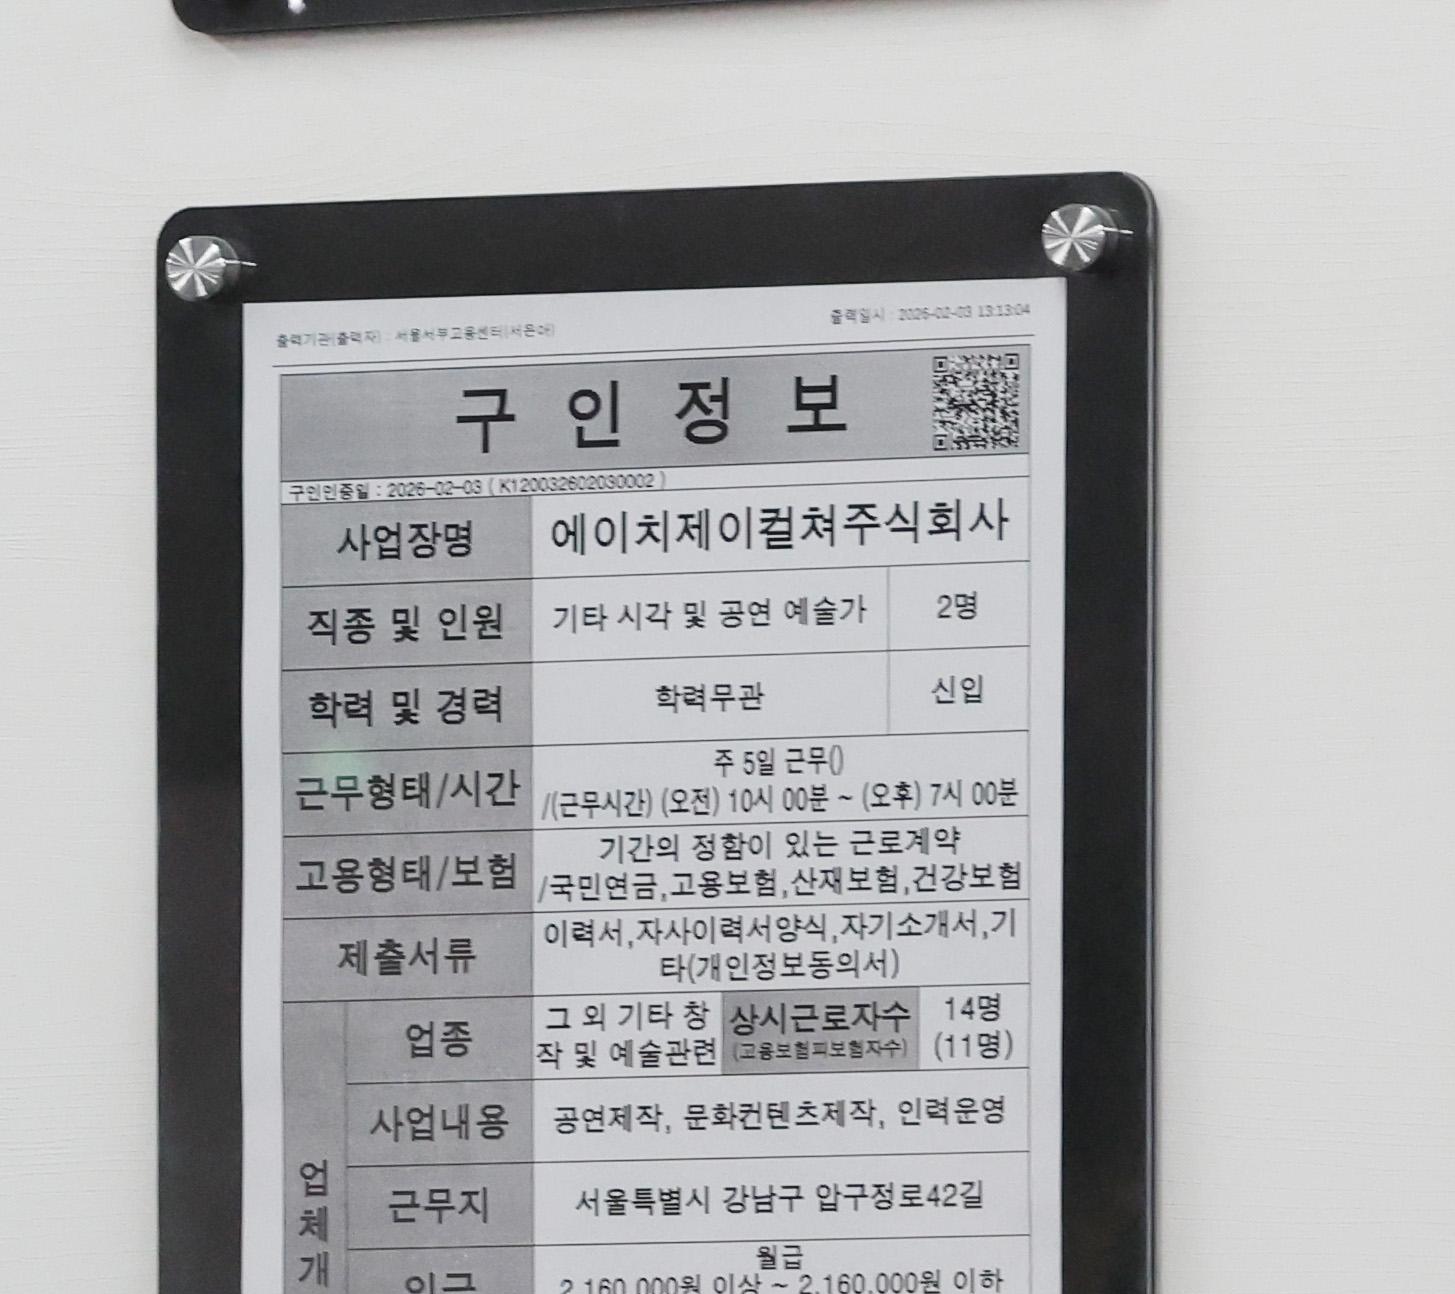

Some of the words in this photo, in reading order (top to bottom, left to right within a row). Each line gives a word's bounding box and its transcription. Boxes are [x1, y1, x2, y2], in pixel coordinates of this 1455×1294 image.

[551, 497, 1010, 556] 에이치제이컬쳐주식회사
[553, 603, 608, 634] 기타
[617, 601, 673, 631] 시각
[684, 600, 705, 630] 및
[718, 598, 770, 629] 공연
[784, 594, 867, 626] 예술가
[931, 674, 983, 705] 신입
[945, 992, 1001, 1023] 14명
[934, 1030, 1013, 1062] (11명)
[575, 1186, 709, 1217] 서울특별시
[723, 1184, 805, 1214] 강남구
[816, 1180, 983, 1213] 압구정로42길
[953, 1268, 1004, 1294] 이하
